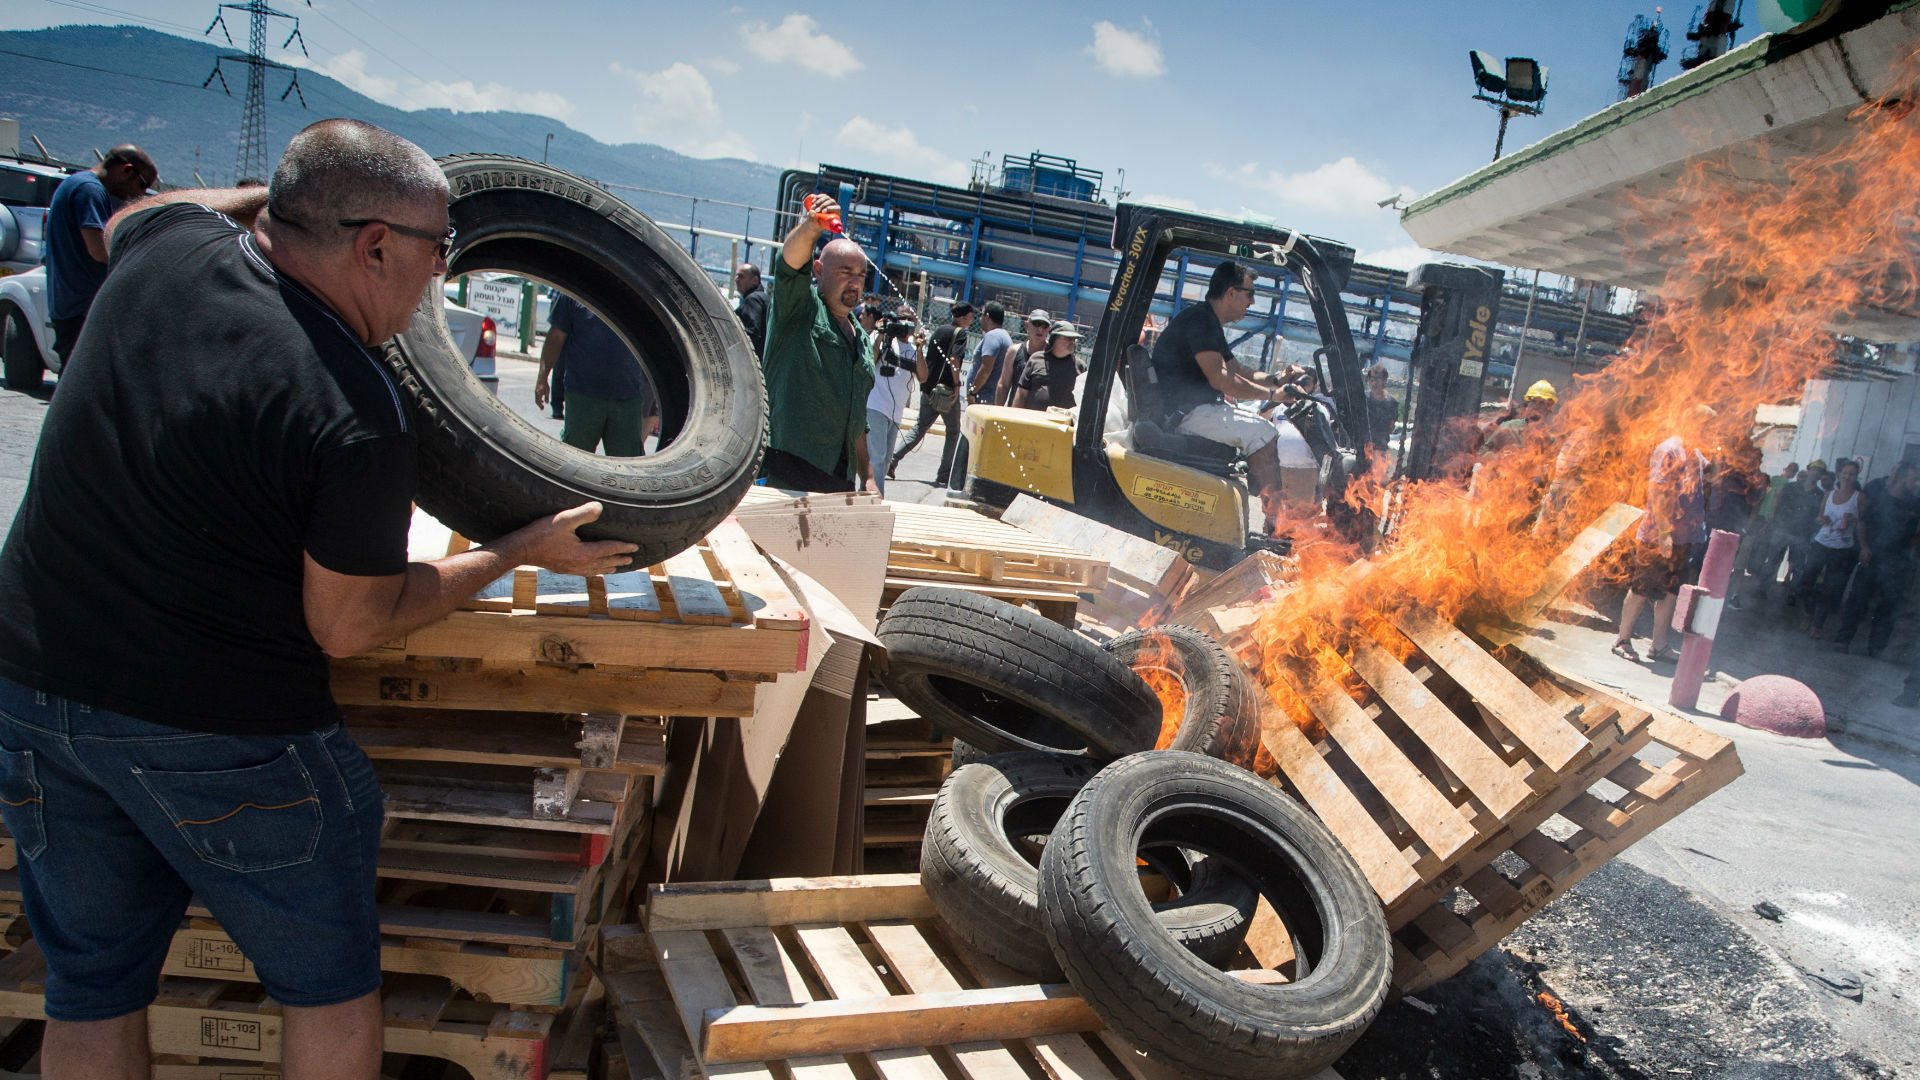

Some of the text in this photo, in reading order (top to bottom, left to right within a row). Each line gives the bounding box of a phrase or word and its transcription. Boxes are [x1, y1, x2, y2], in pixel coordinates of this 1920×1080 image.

[455, 171, 594, 205] BRIDGESTONE
[1109, 225, 1148, 312] Veracitor 30VX
[474, 292, 515, 304] מגדל העמק
[1463, 306, 1491, 358] Yale
[600, 465, 715, 492] DURAVIS
[1154, 529, 1204, 563] Yale
[204, 942, 241, 955] IL-102
[204, 957, 223, 967] HT
[220, 1021, 257, 1034] IL-102
[220, 1035, 239, 1046] HT
